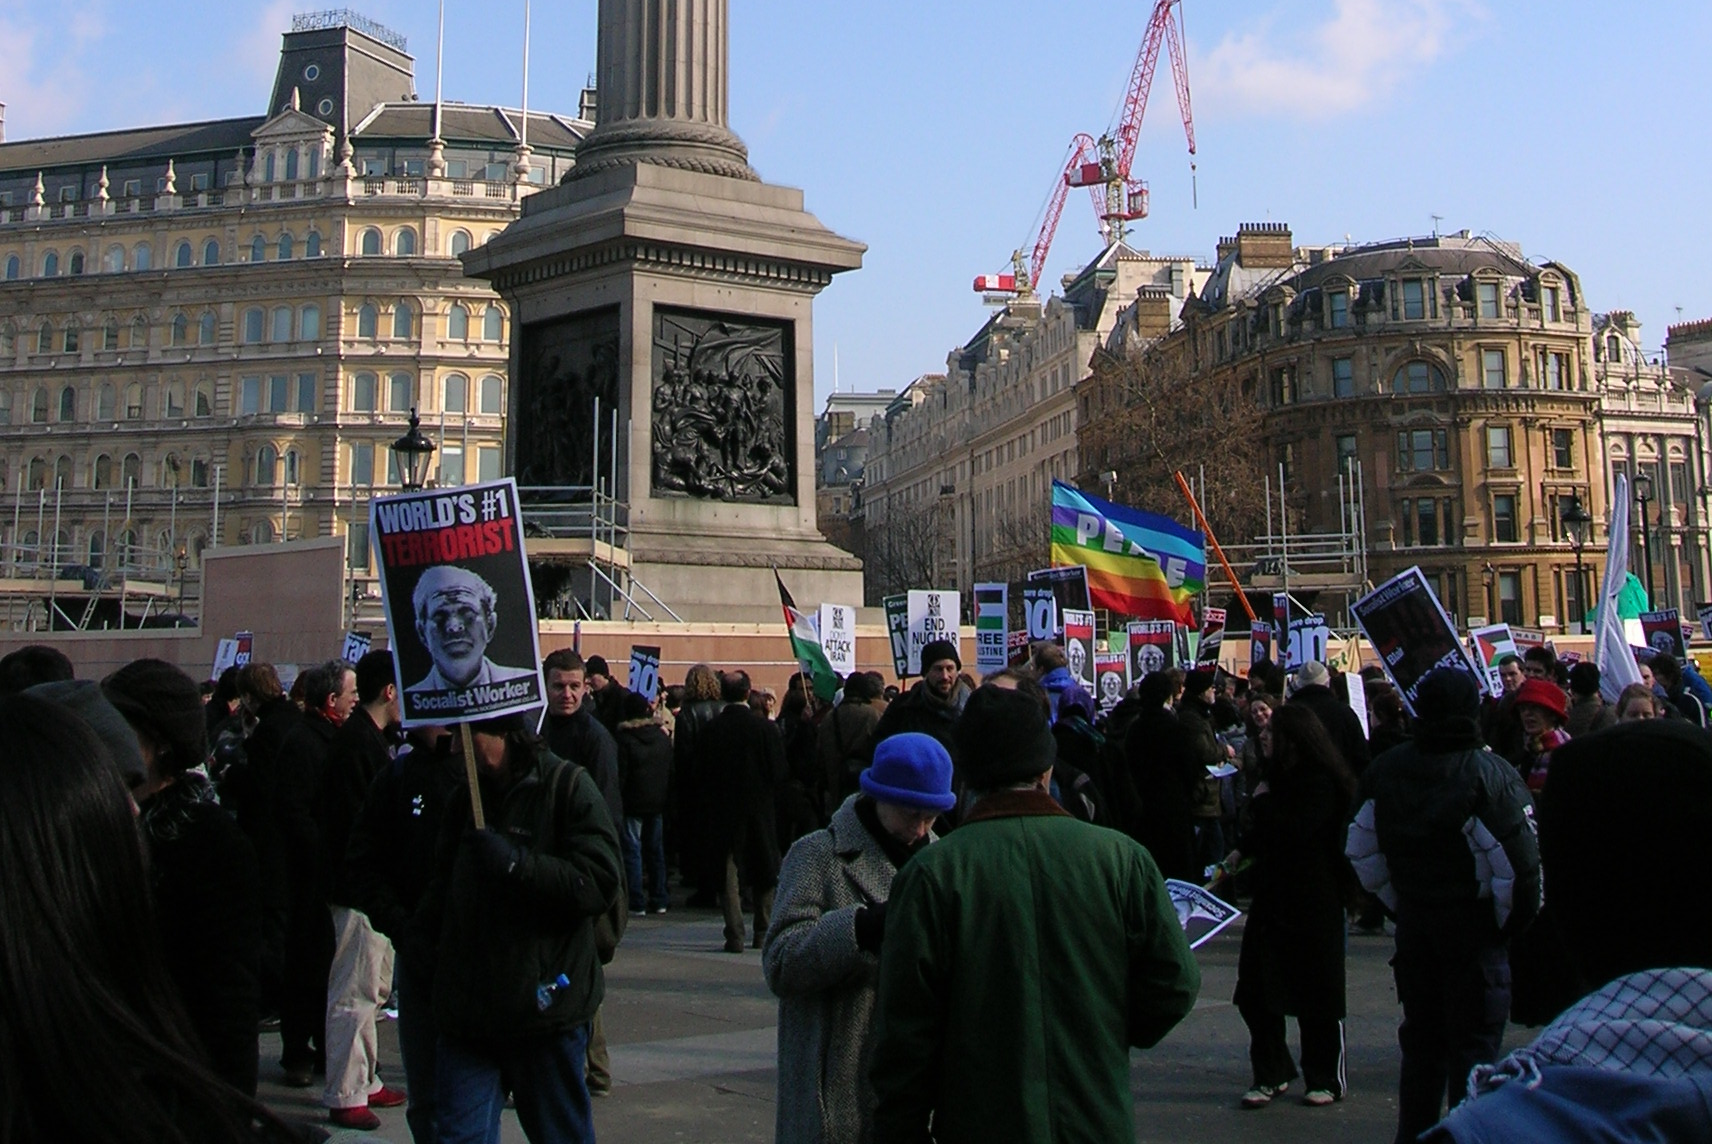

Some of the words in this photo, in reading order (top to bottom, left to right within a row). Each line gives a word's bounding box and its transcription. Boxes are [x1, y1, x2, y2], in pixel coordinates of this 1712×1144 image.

[378, 494, 477, 534] WORLD'S
[482, 489, 509, 521] #1
[383, 518, 514, 567] TERRORIST
[1384, 576, 1416, 602] Worker
[924, 618, 945, 631] END
[825, 639, 851, 653] ATTACK
[977, 633, 1003, 645] REE
[412, 690, 474, 710] Socialist
[473, 681, 531, 707] Worker
